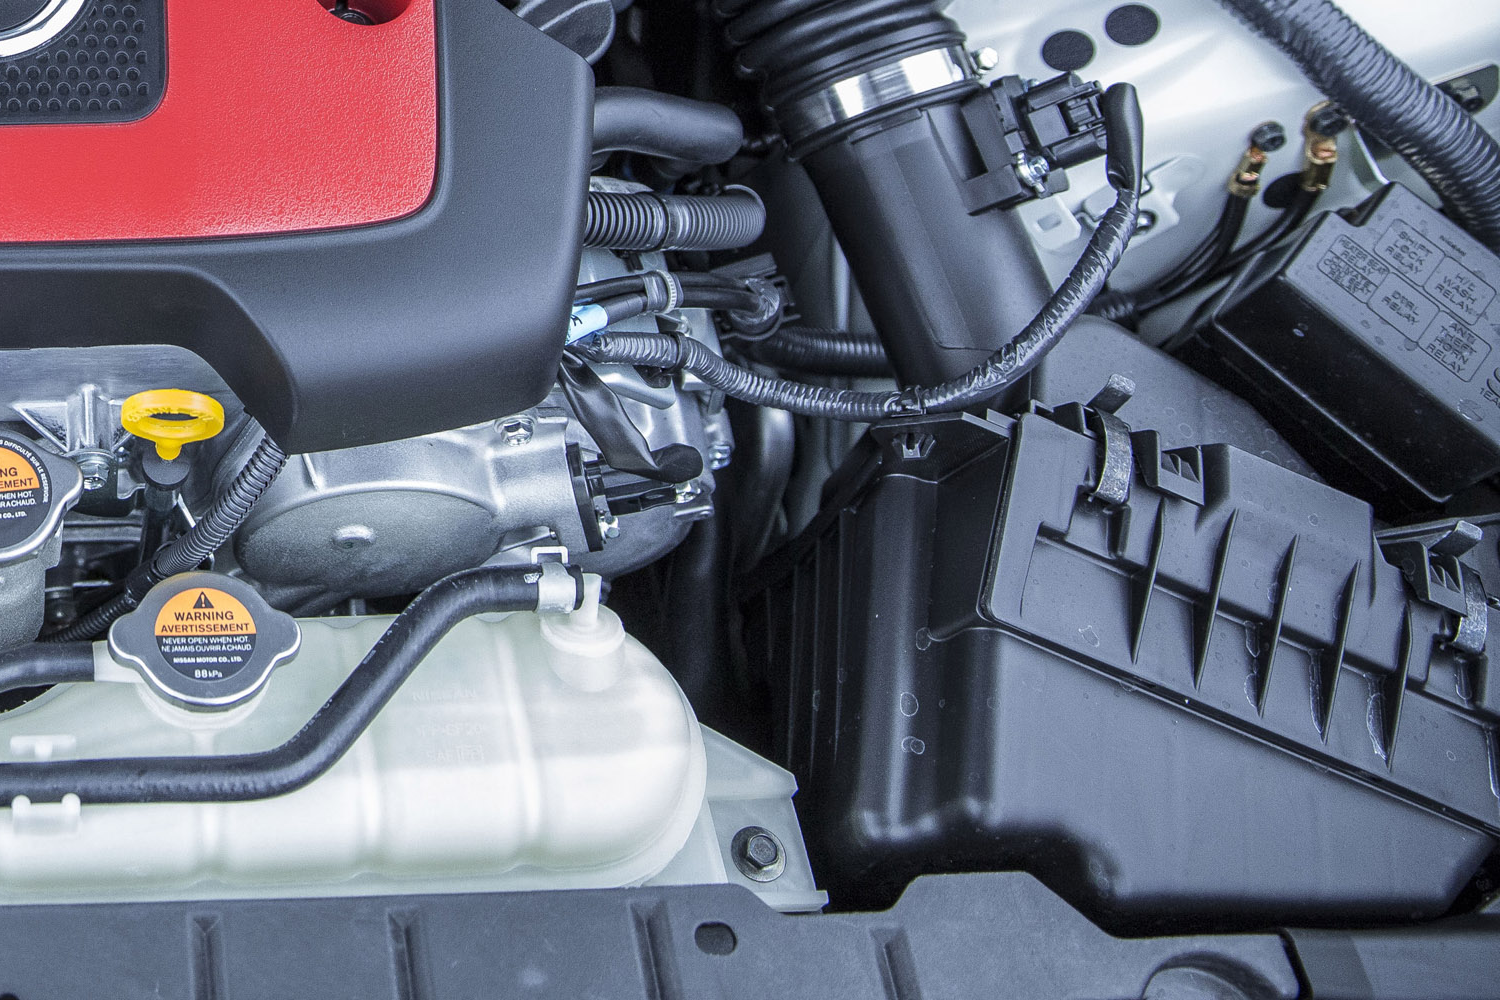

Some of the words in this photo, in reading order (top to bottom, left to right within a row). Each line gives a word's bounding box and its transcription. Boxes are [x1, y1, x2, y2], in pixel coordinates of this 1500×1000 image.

[1338, 237, 1368, 262] HEATER
[1366, 258, 1387, 276] SEAT
[1393, 240, 1425, 266] LOCK
[1399, 231, 1433, 257] SHIFT
[1331, 255, 1372, 288] CLIMATE
[1340, 250, 1374, 276] RELAY
[1385, 245, 1422, 274] RELAY
[1328, 269, 1357, 294] RELAY
[1443, 276, 1477, 305] WASH
[1381, 296, 1419, 325] RELAY
[1435, 284, 1471, 313] RELAY
[1440, 325, 1477, 353] THEFT
[1448, 322, 1476, 344] ANTI
[1425, 343, 1465, 374] RELAY
[1434, 336, 1469, 364] HORN
[30, 456, 40, 467] SUR
[37, 466, 44, 474] LE
[11, 498, 36, 507] CHAUD.
[17, 490, 34, 498] HOT.
[161, 622, 250, 633] AVERTISSEMENT
[174, 611, 234, 621] WARNING
[163, 637, 187, 645] NEVER
[209, 636, 232, 644] WHEN
[171, 645, 195, 653] JAMAIS
